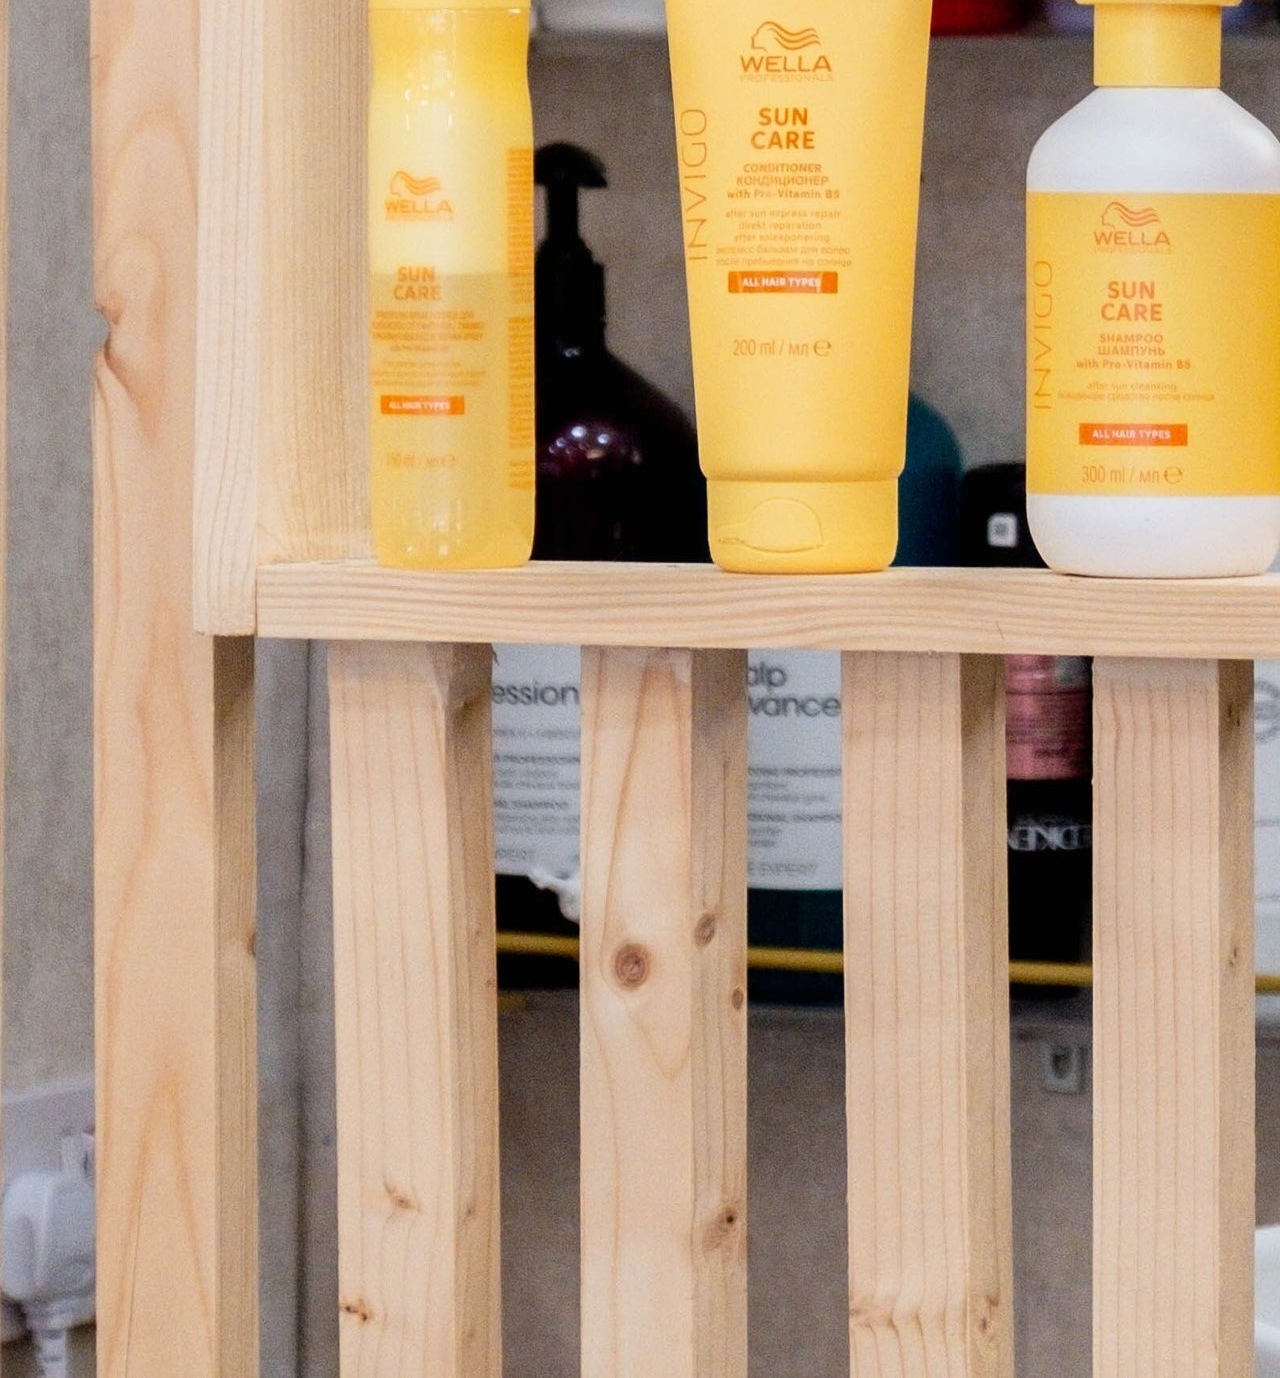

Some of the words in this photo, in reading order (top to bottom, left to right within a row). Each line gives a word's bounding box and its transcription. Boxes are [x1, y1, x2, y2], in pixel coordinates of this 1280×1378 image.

[740, 55, 832, 73] WELLA
[758, 107, 809, 127] SUN
[750, 131, 816, 150] CARE
[743, 163, 822, 173] CONDITIONER
[680, 109, 708, 261] INVIGO
[727, 188, 750, 199] with
[384, 199, 453, 215] WELLA
[1094, 230, 1171, 246] WELLA
[397, 266, 435, 283] SUN
[742, 277, 760, 287] ALL
[762, 277, 787, 287] HAIR
[789, 277, 822, 287] TYPES
[393, 285, 442, 301] CARE
[1107, 280, 1156, 300] SUN
[1101, 303, 1163, 322] CARE
[1033, 260, 1054, 409] INVIGO
[1100, 333, 1164, 344] SHAMPOO
[733, 339, 757, 357] 200
[760, 339, 775, 356] ml
[1098, 345, 1166, 357] ШАМПУНЬ
[1076, 358, 1099, 369] with
[1103, 358, 1172, 370] Pro-Vitamin
[1092, 429, 1110, 439] ALL
[1139, 429, 1171, 440] TYPES
[1081, 466, 1106, 484] 300
[1110, 466, 1126, 483] ml
[492, 680, 580, 706] ession
[747, 697, 841, 717] vance
